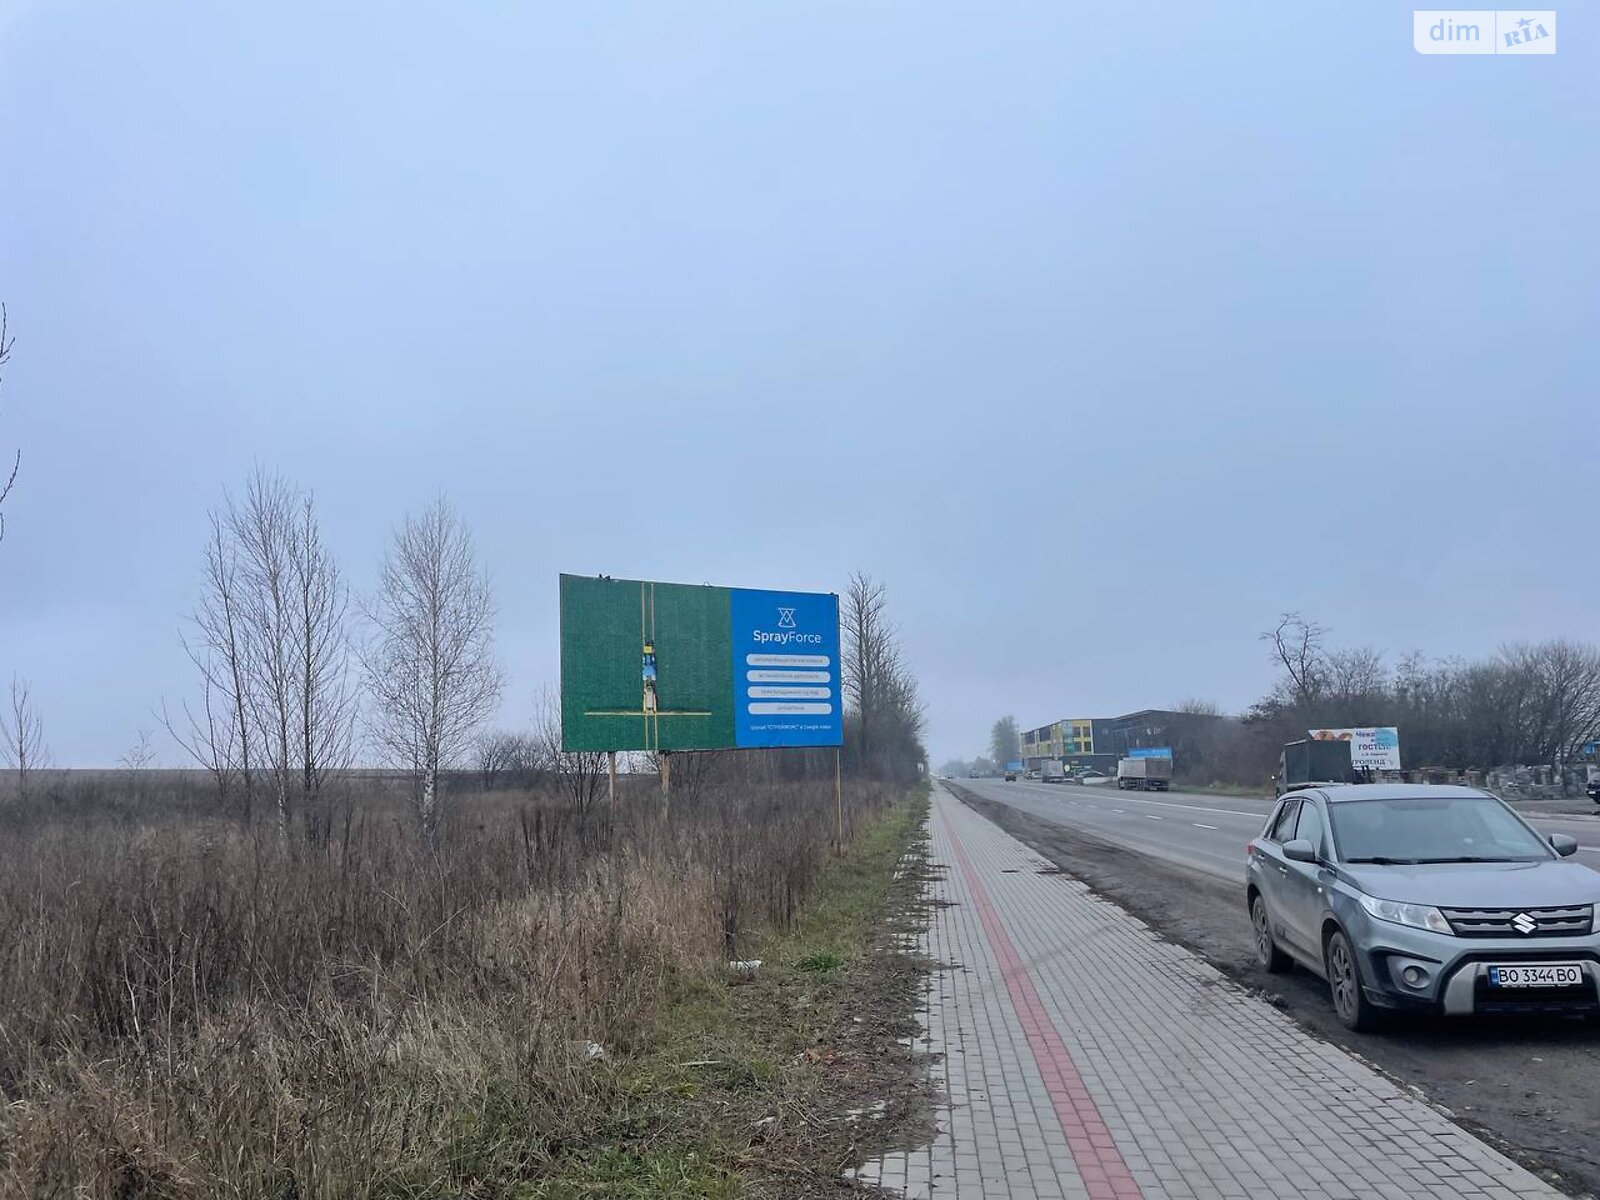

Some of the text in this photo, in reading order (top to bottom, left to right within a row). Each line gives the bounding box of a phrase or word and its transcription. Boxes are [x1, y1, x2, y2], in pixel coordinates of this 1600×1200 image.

[753, 630, 822, 644] SprayForce
[1498, 968, 1577, 983] BO 3344 BO
